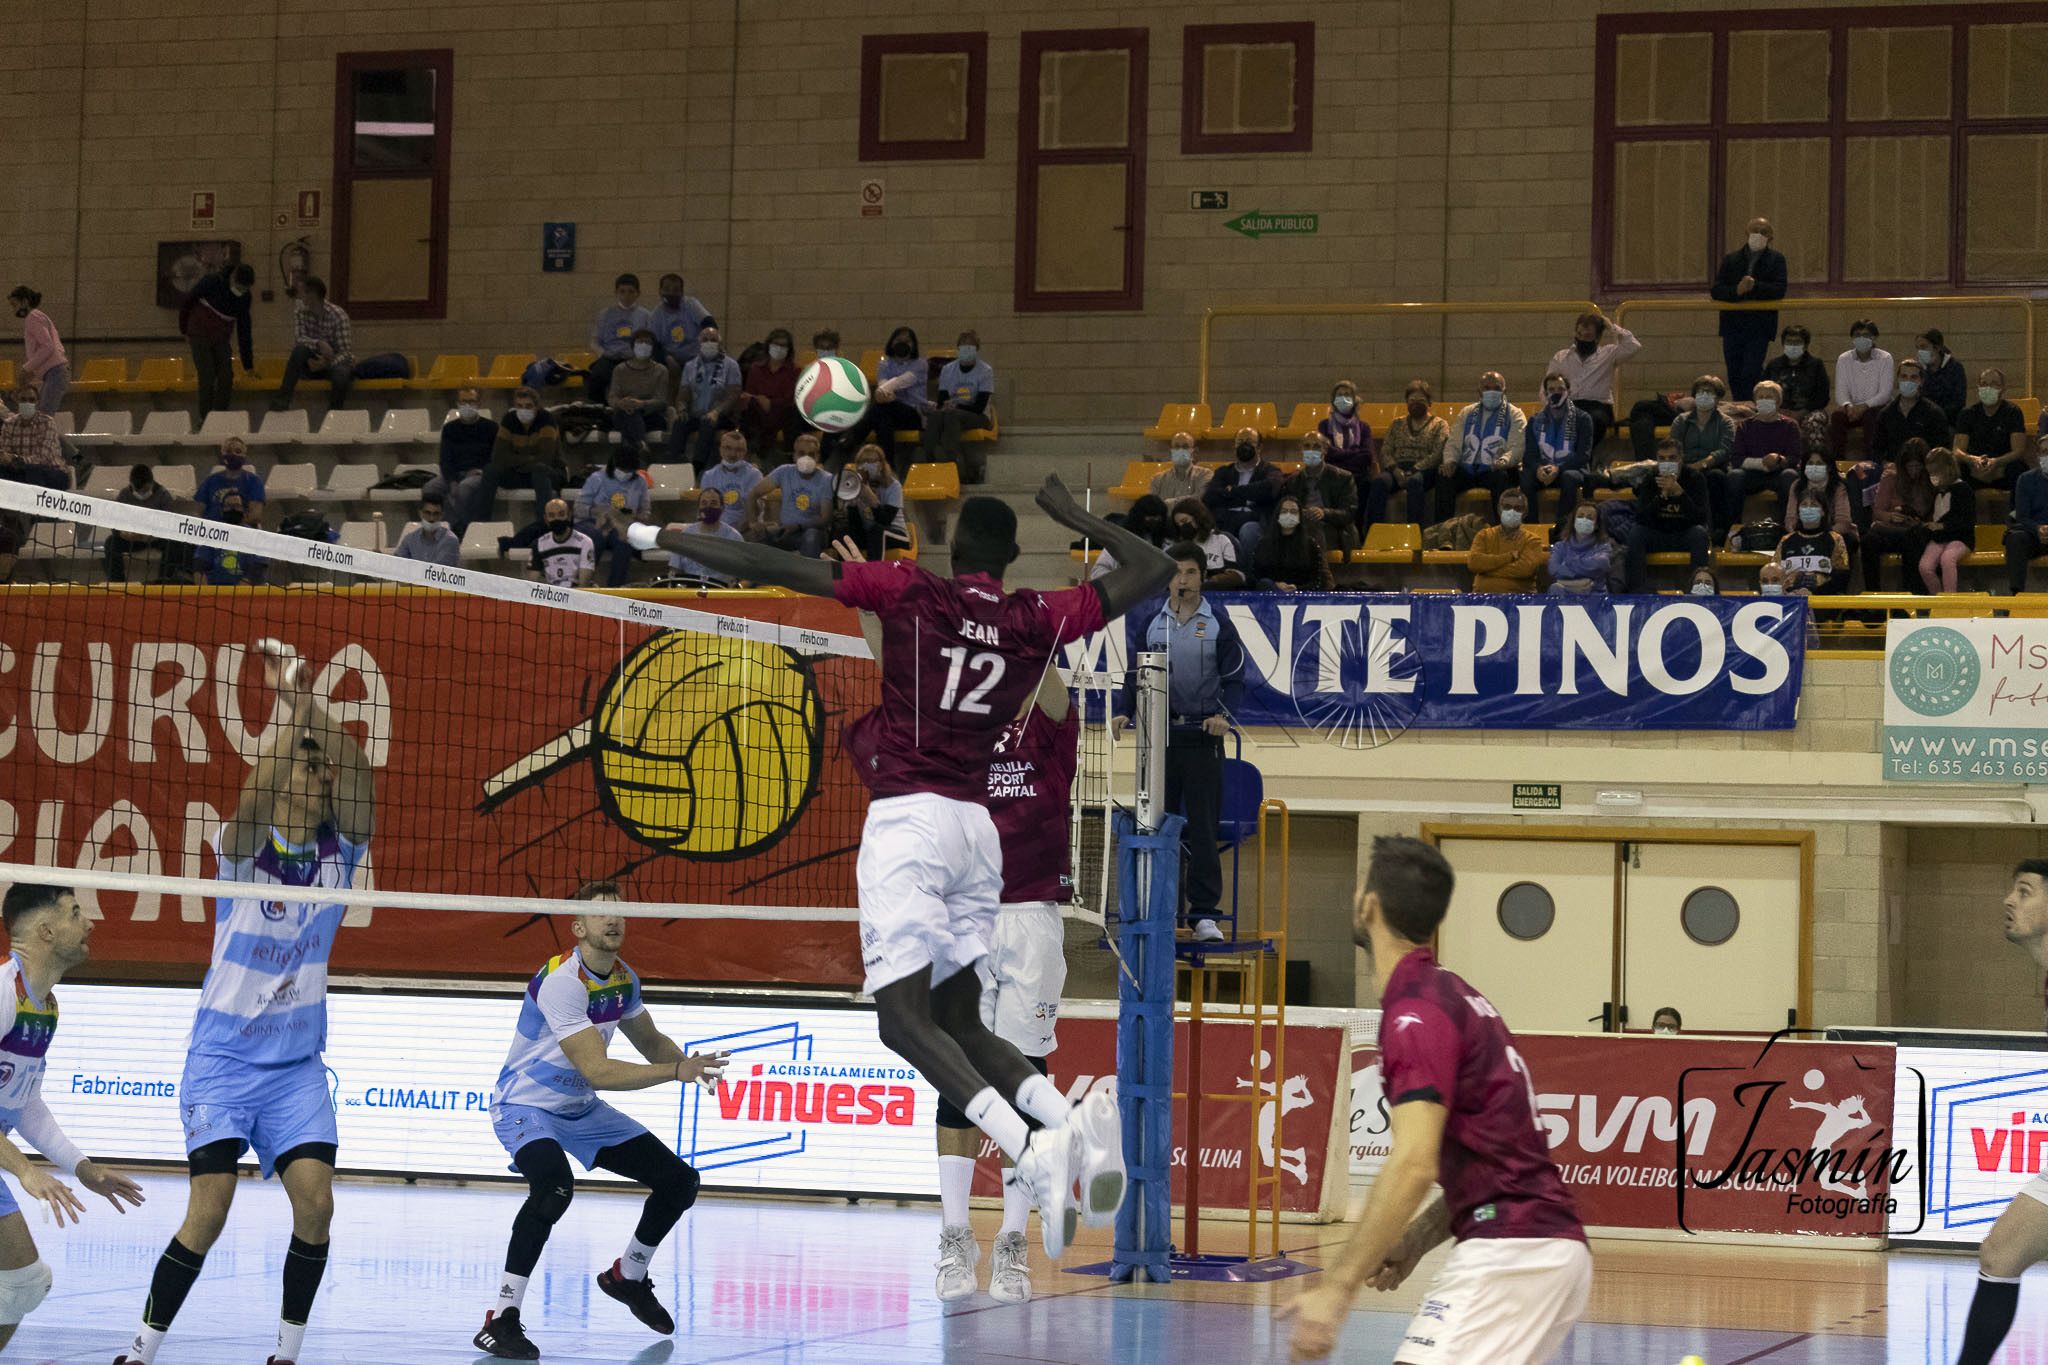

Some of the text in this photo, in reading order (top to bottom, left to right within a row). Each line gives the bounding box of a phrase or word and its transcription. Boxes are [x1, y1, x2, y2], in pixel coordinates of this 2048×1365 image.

[1240, 217, 1314, 230] SALIDA PUBLICO
[35, 490, 92, 517] rfevb.com
[178, 519, 230, 543] rfevb.com
[307, 545, 354, 566] rfevb.com
[424, 565, 466, 587] rfevb.com
[530, 584, 570, 605] rfevb.com
[628, 603, 663, 621] rfevb.com
[800, 630, 829, 648] rfevb.com
[957, 617, 1000, 647] JEAN
[1056, 601, 1791, 697] MNTE PINOS
[940, 646, 1006, 715] 12
[0, 642, 393, 767] URVA
[1891, 759, 2048, 776] Tel: 635 463 665
[1514, 797, 1559, 807] EMERGENCIA
[1516, 786, 1558, 796] SALIDA DE
[768, 1064, 916, 1080] ACRISTALAMIENTOS
[72, 1074, 175, 1097] Fabricante
[717, 1063, 915, 1126] vinuesa
[365, 1087, 461, 1111] CLIMALIT
[466, 1091, 493, 1112] PL
[1554, 1163, 1602, 1186] LIGA
